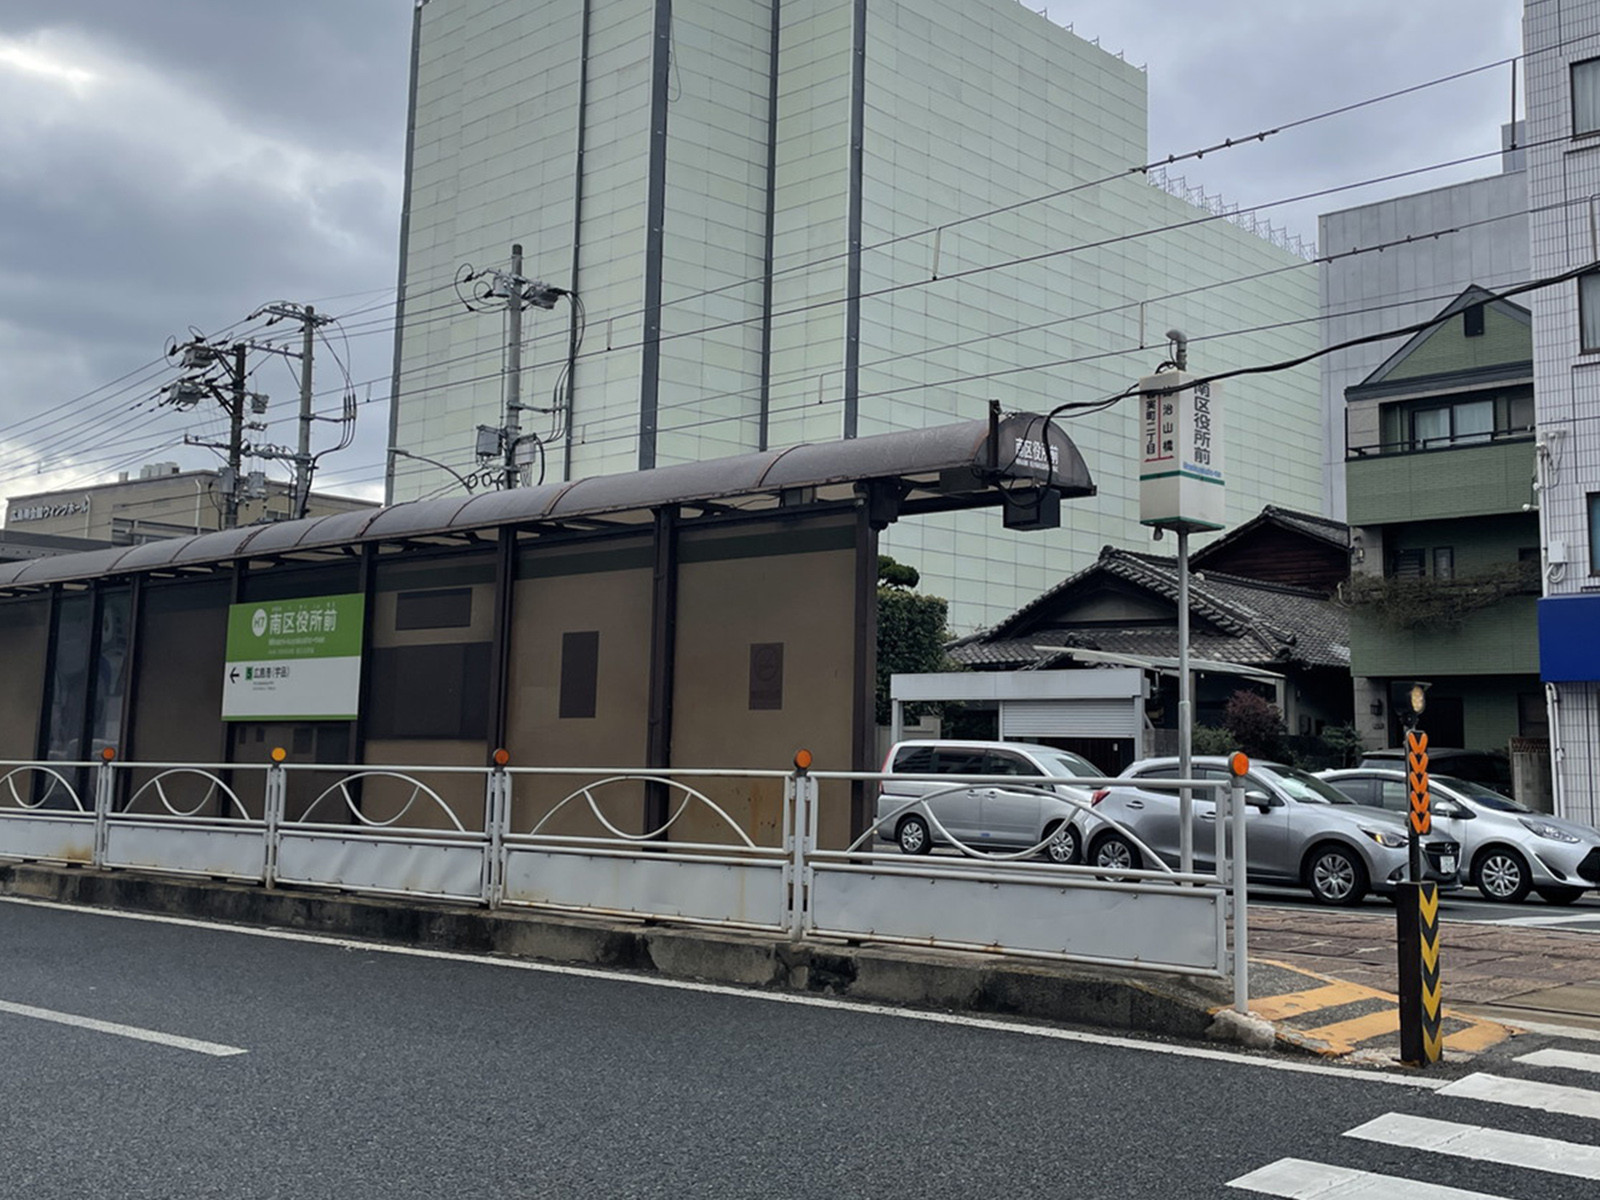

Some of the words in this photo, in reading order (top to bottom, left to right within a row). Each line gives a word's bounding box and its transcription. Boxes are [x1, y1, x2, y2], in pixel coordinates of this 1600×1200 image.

[269, 608, 338, 635] 南区役所前
